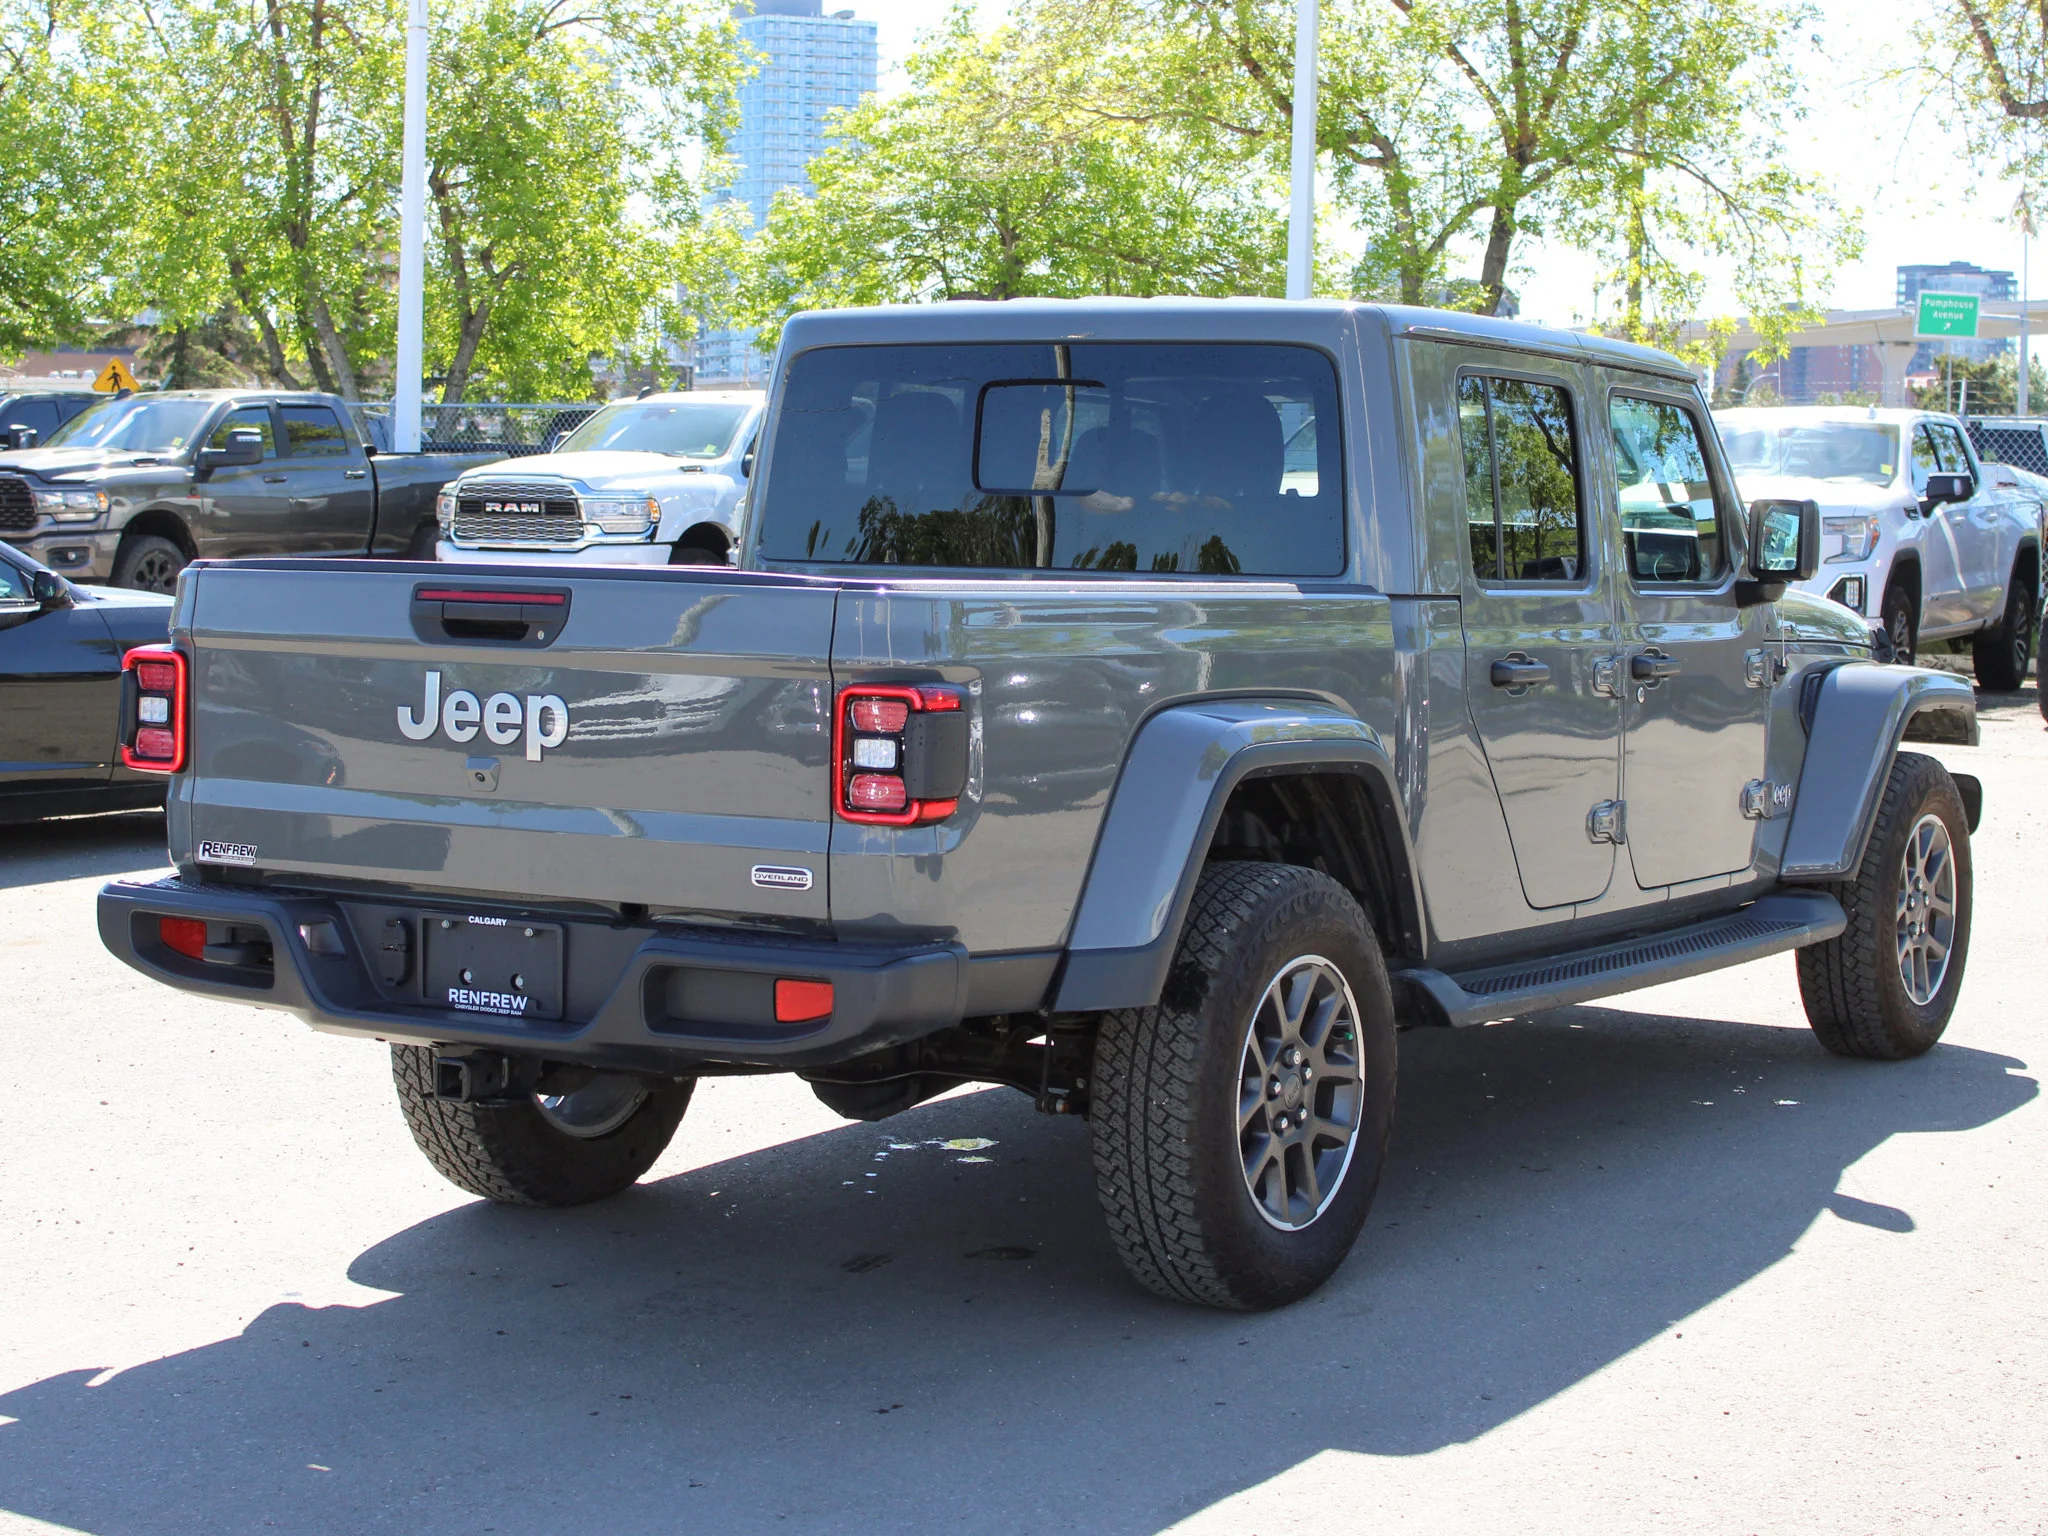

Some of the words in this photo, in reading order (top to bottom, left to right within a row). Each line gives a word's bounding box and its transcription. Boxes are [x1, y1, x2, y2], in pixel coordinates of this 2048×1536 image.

[1925, 298, 1974, 310] Pumphouse
[1933, 310, 1964, 320] Avenue
[485, 502, 539, 513] RAM
[397, 671, 568, 761] Jeep
[1774, 784, 1791, 808] eep
[202, 841, 256, 857] RENFREW
[754, 873, 808, 883] OVERLAND
[468, 915, 507, 927] CALGARY
[448, 988, 528, 1010] RENFREW
[454, 1003, 480, 1012] CHRYSLER
